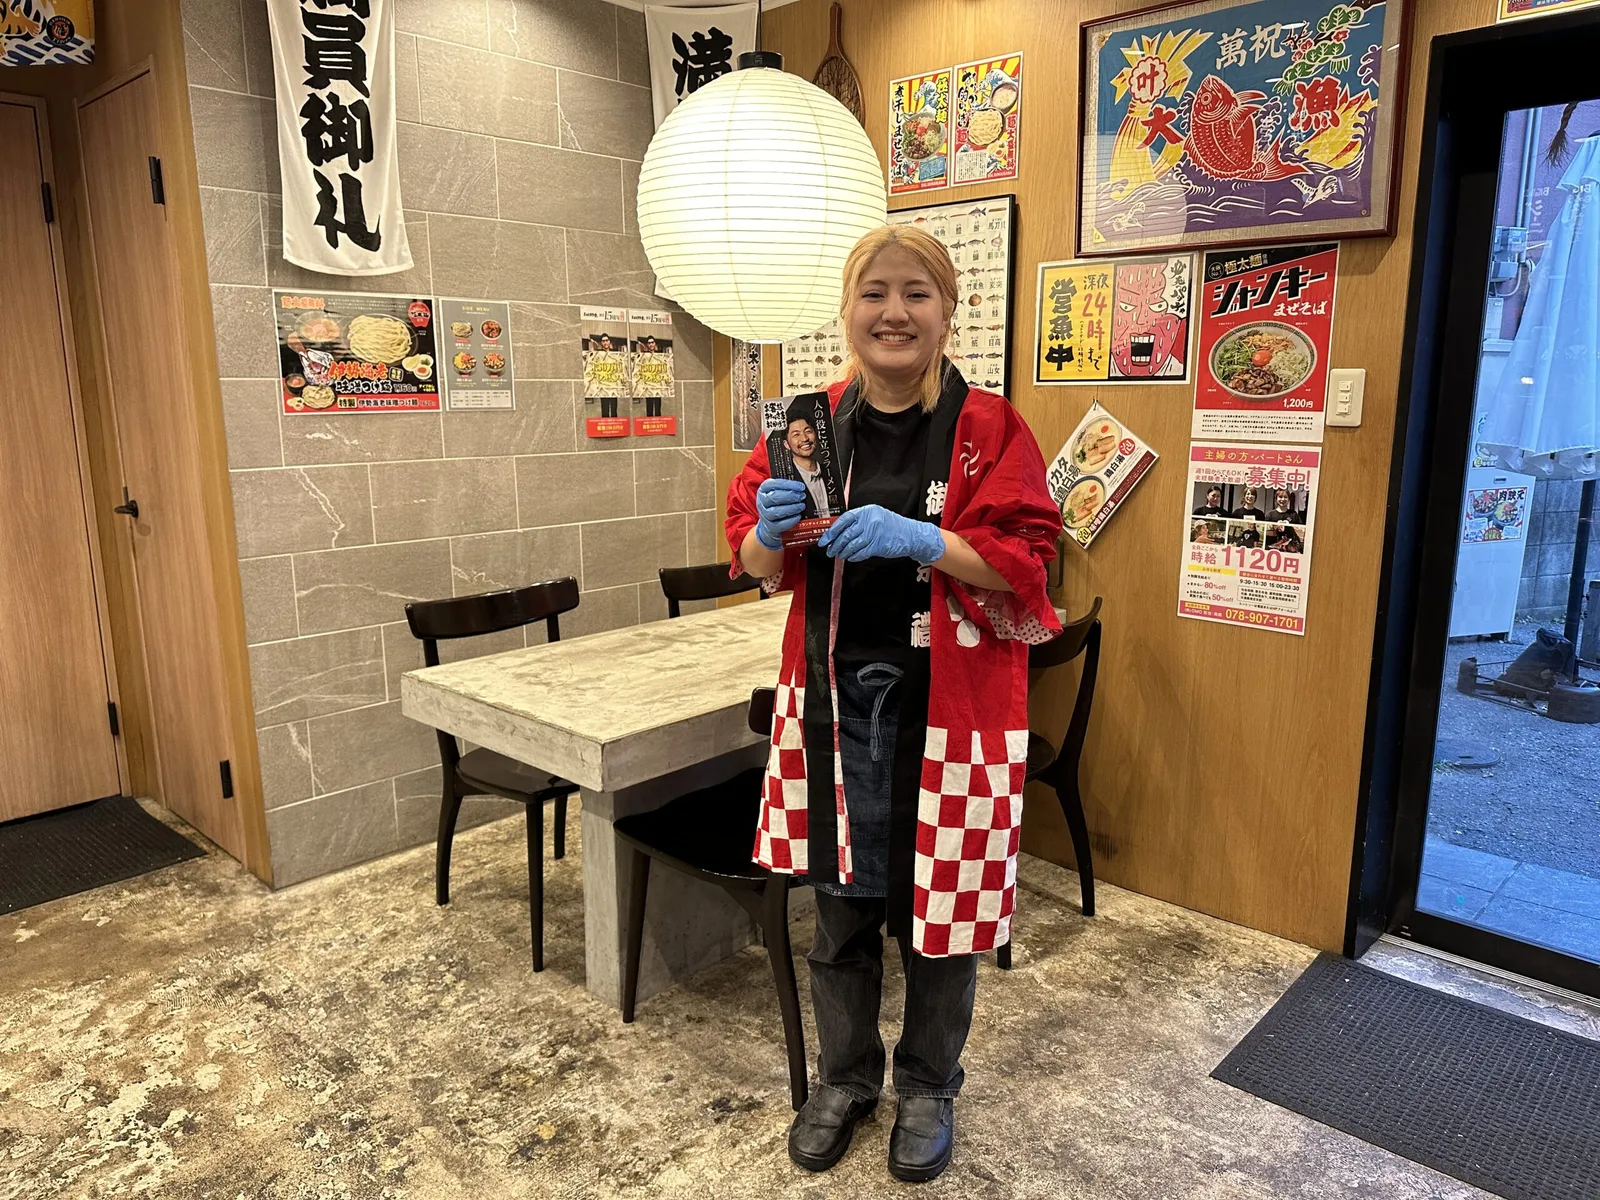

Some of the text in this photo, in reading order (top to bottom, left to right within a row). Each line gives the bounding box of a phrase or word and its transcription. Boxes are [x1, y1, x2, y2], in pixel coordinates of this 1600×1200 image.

[1215, 22, 1285, 70] 萬祝
[1136, 63, 1159, 95] 叶
[1136, 76, 1342, 150] 大 漁
[893, 85, 905, 176] 煮干しまぜそば
[1224, 253, 1263, 275] 極太麺
[1083, 272, 1110, 291] 深夜
[1210, 264, 1328, 318] ジャンキー
[1273, 300, 1328, 317] まぜそば
[328, 361, 388, 380] 伊勢海老
[335, 380, 392, 394] 味噌つけ麺
[1283, 398, 1314, 409] 1,200円
[813, 399, 839, 505] 人の役に立つラーメン屋
[1205, 449, 1304, 464] 主婦の方・パートさん
[1191, 545, 1300, 574] 時給 1120円
[1225, 608, 1299, 629] 078-907-1701
